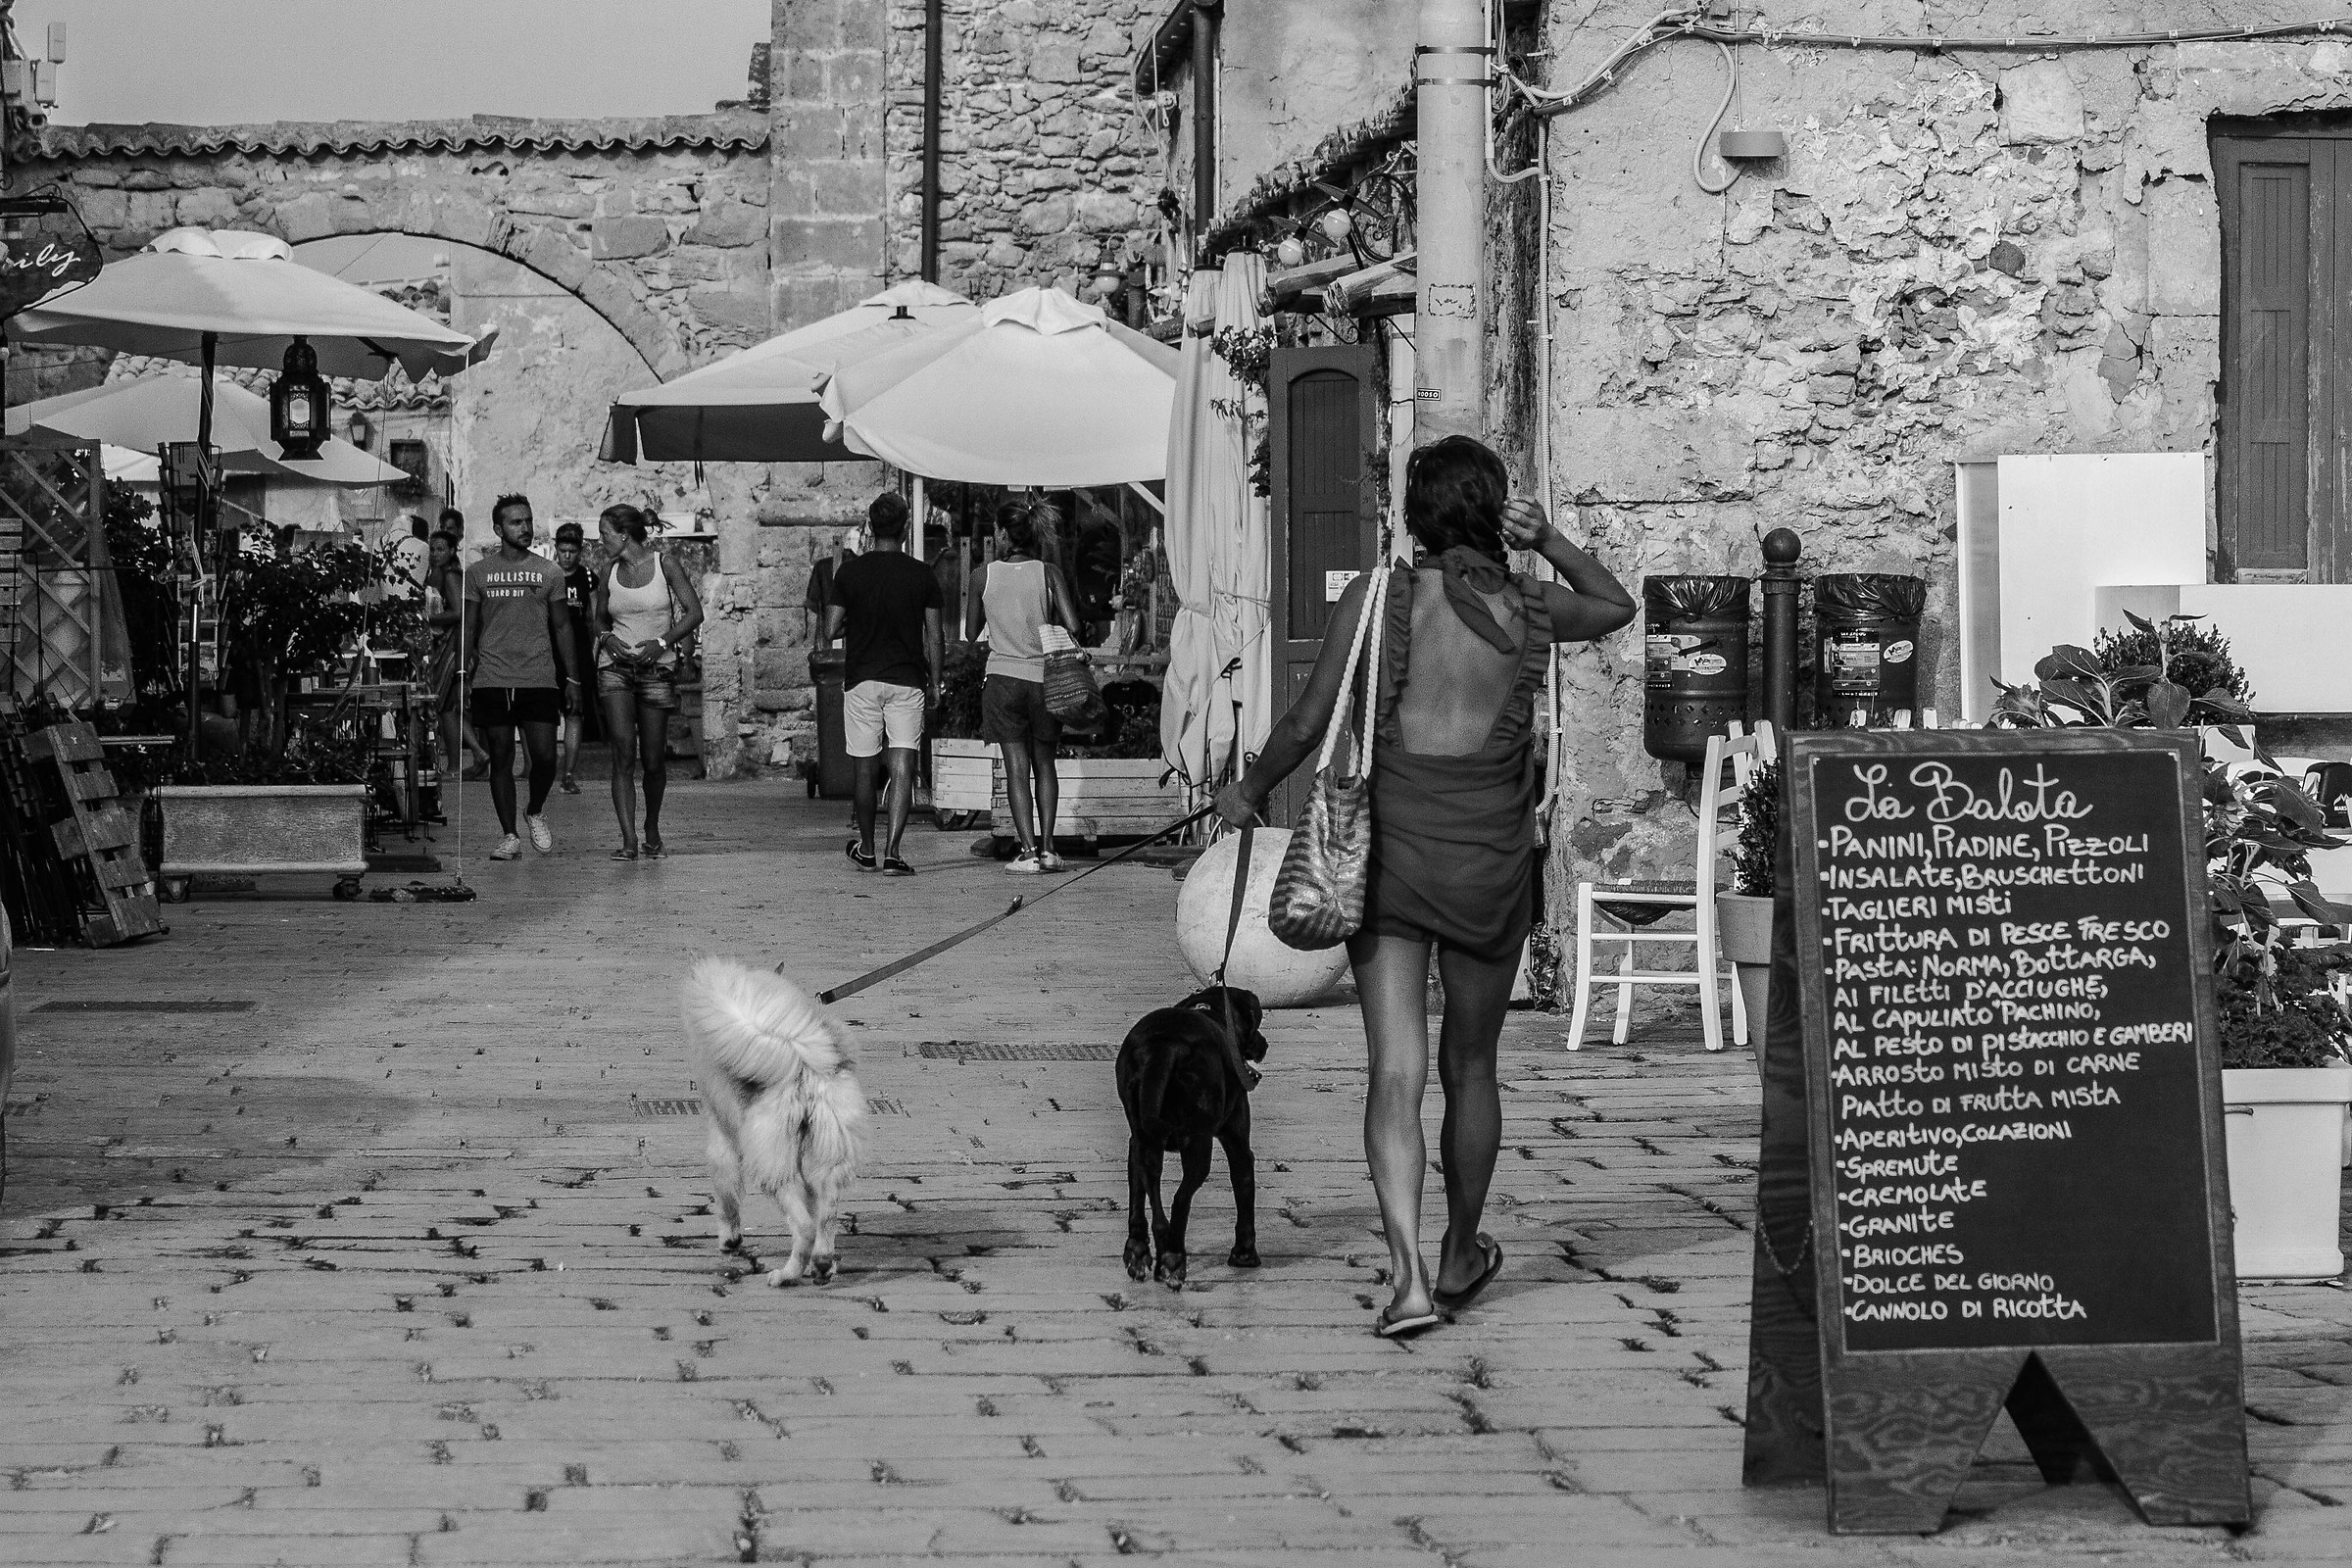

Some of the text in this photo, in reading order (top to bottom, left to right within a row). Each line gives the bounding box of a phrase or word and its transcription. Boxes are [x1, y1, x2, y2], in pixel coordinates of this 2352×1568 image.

[4, 243, 81, 277] ily
[487, 571, 543, 583] HOLLISTER
[1844, 761, 2094, 822] La Balata
[2043, 823, 2149, 858] PIZZOLI
[1827, 896, 1937, 921] TAGLIERI
[1968, 927, 1990, 947] DI
[2000, 921, 2073, 945] PESCE
[2077, 915, 2171, 944] FRESCO
[1922, 954, 2011, 979] NORMA,
[1834, 987, 1859, 1007] AI
[1834, 1011, 1866, 1034] AL
[1834, 1037, 1867, 1060] AL
[1951, 1035, 1973, 1054] DI
[2092, 1027, 2107, 1046] E
[2109, 1021, 2193, 1047] GAMBERI
[2034, 1059, 2055, 1076] DI
[2066, 1052, 2141, 1074] CARNE
[1932, 1097, 1951, 1114] DI
[1960, 1120, 2073, 1143] COLAZIONI
[1853, 1243, 1964, 1269] BRIOCHES
[1852, 1272, 2055, 1295] DOLCE DEL GIORNO
[1850, 1299, 1948, 1321] CANNOLO
[1961, 1300, 1982, 1318] DI
